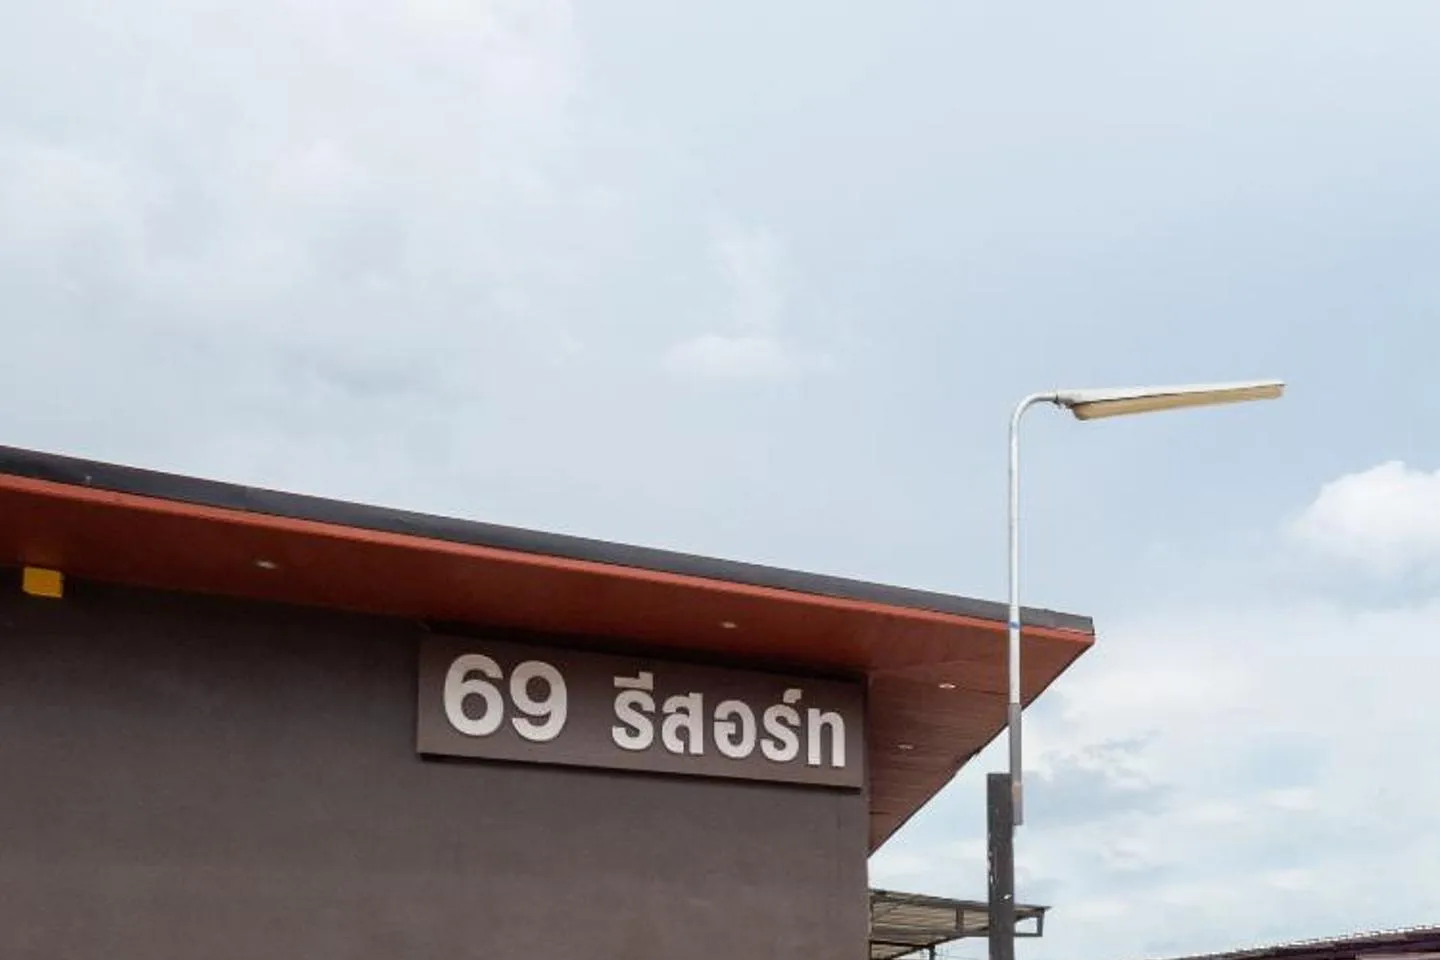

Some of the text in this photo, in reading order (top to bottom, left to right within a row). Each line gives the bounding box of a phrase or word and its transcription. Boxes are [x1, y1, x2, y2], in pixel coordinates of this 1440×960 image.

[444, 653, 846, 767] 69 รีสอร์ท
